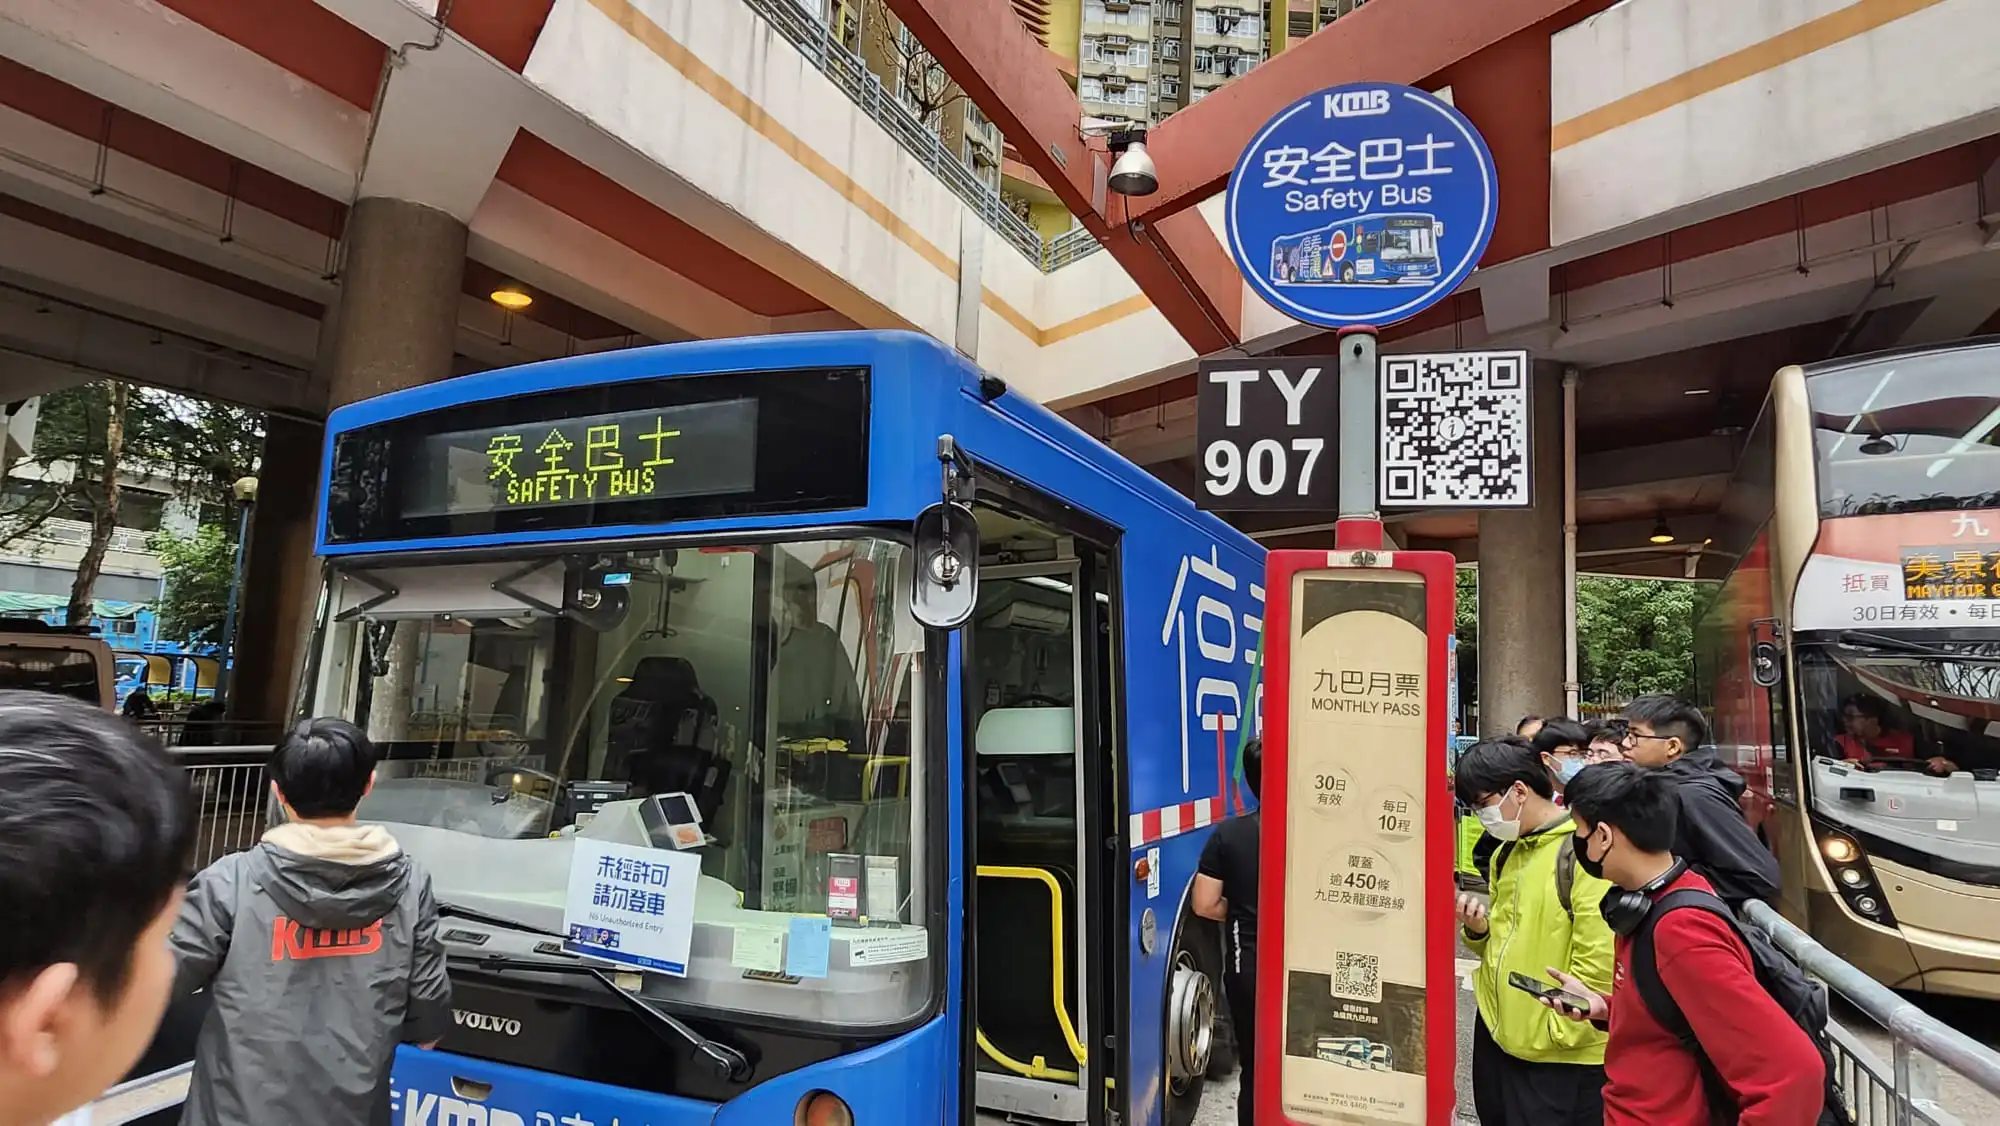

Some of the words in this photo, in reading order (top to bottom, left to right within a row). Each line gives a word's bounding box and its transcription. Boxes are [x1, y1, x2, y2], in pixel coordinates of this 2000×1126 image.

[1324, 90, 1390, 118] KMB
[1263, 133, 1455, 188] 安全巴士
[1285, 188, 1373, 213] Safety
[1381, 184, 1432, 206] Bus
[1209, 367, 1322, 427] TY
[487, 416, 681, 480] 安全巴士
[1204, 438, 1324, 496] 907
[507, 472, 598, 503] SAFETY
[610, 468, 655, 496] BUS
[1842, 573, 1889, 593] 抵買
[1907, 583, 1986, 599] MAYFAIR
[1312, 668, 1421, 698] 九巴月票
[1311, 697, 1380, 715] MONTHLY
[1383, 702, 1420, 717] PASS
[1314, 774, 1346, 791] 30日
[1317, 792, 1342, 806] 有效
[1382, 800, 1408, 813] 每日
[1378, 814, 1411, 832] 10程
[597, 855, 670, 888] 未經許可
[1348, 854, 1374, 869] 覆蓋
[593, 882, 666, 916] 請勿登車
[1314, 888, 1405, 911] 九巴及龍運路線
[589, 911, 599, 920] No
[644, 921, 664, 934] Entry
[271, 915, 383, 961] KMB
[452, 1009, 521, 1036] VOLVO
